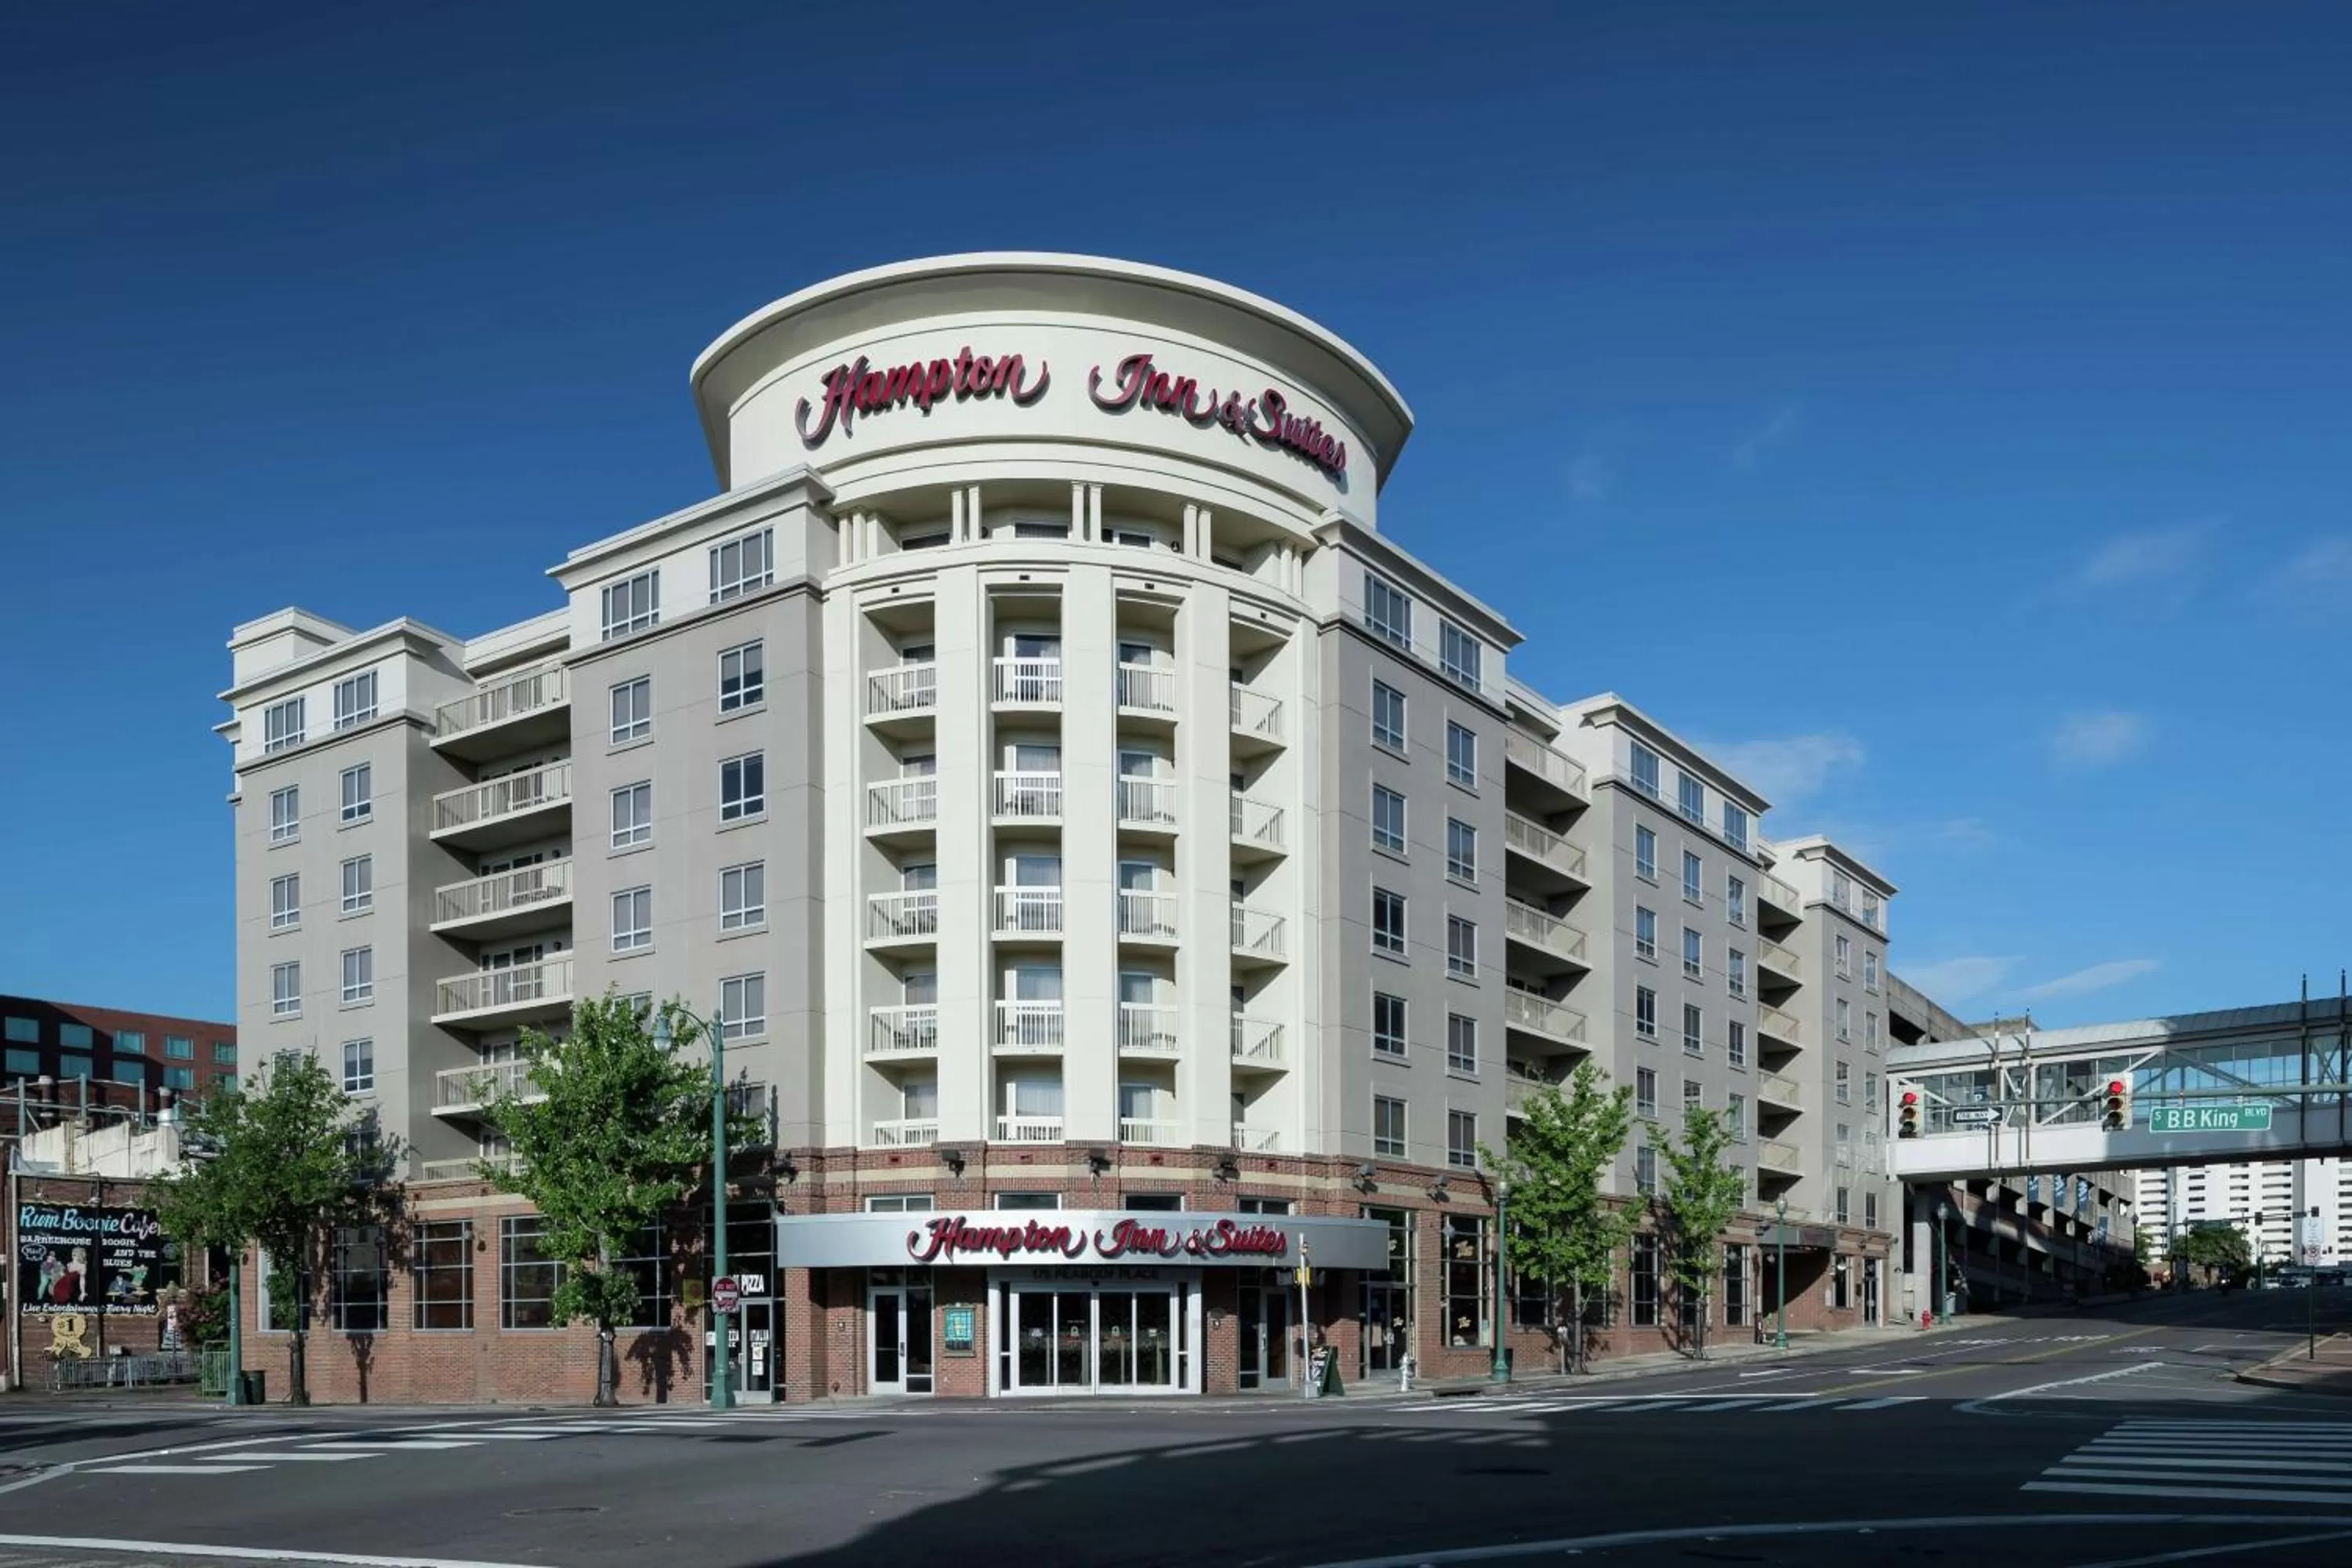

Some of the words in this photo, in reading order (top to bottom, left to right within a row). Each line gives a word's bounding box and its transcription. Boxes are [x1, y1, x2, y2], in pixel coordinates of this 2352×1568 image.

[795, 345, 1051, 451] Hampton
[1088, 354, 1218, 428] Inn
[1219, 390, 1250, 444] &
[1245, 388, 1348, 480] Suites
[2154, 1111, 2161, 1121] S
[2200, 1108, 2238, 1128] King
[2244, 1108, 2267, 1117] BLVD
[20, 1205, 60, 1229] Rum
[62, 1208, 120, 1236] Boogie
[906, 1215, 1087, 1264] Hampton
[1094, 1218, 1181, 1258] Inn
[1184, 1229, 1208, 1260] &
[1205, 1218, 1288, 1258] Suites
[741, 1274, 764, 1295] PIZZA
